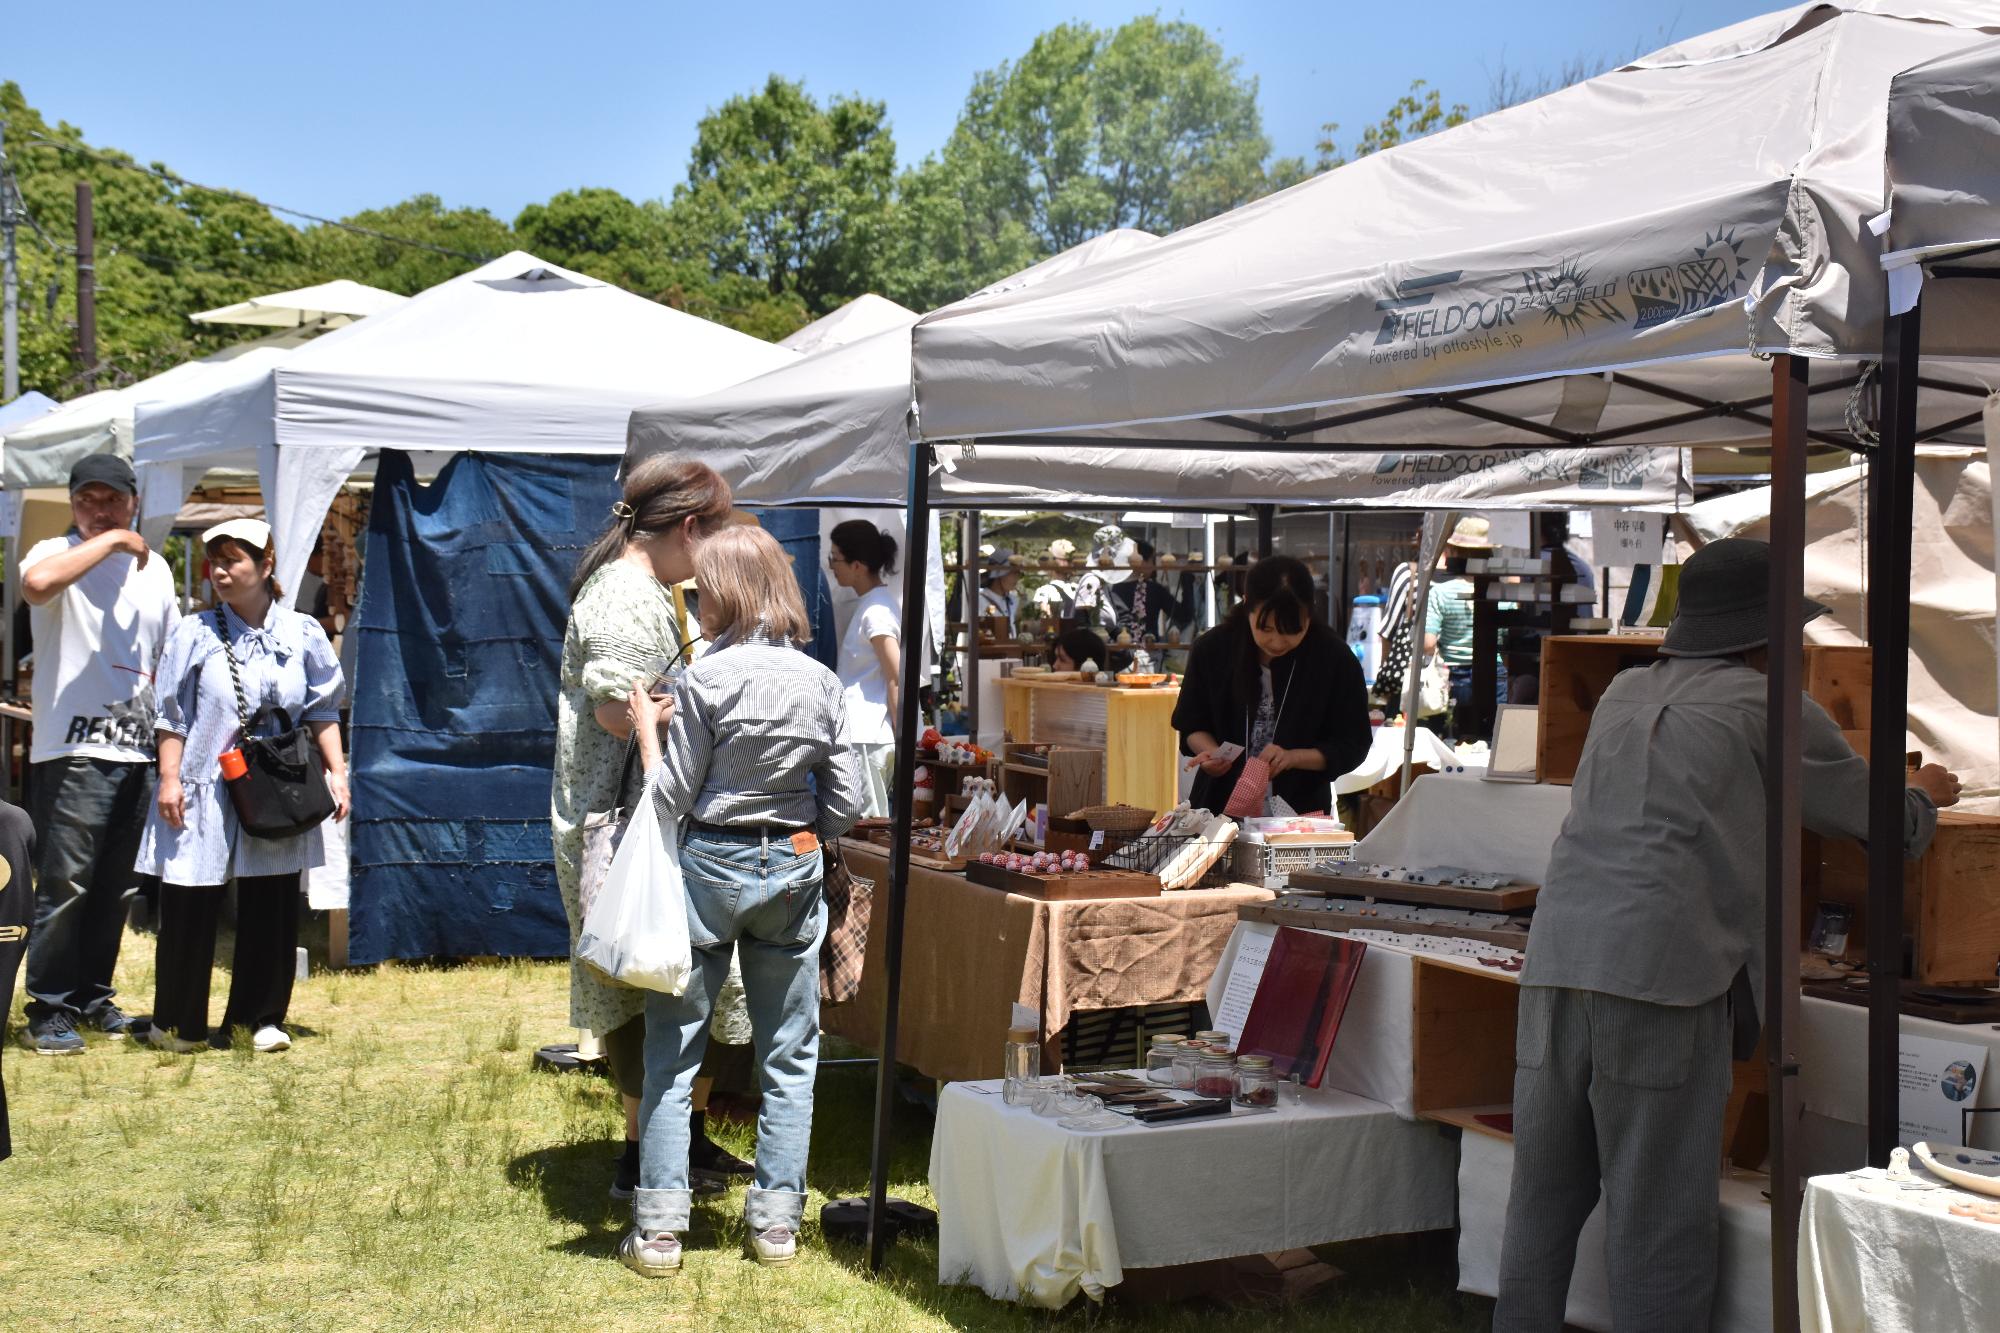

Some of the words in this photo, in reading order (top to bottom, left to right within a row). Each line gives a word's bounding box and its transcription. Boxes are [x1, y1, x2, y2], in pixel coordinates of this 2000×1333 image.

[1401, 296, 1516, 341] FIELDOOR
[1369, 341, 1418, 365] Powered
[1423, 341, 1437, 360] by
[1443, 331, 1523, 355] ottostyle.jp
[1401, 454, 1496, 473] FIELDOOR
[1371, 476, 1415, 486] Powered
